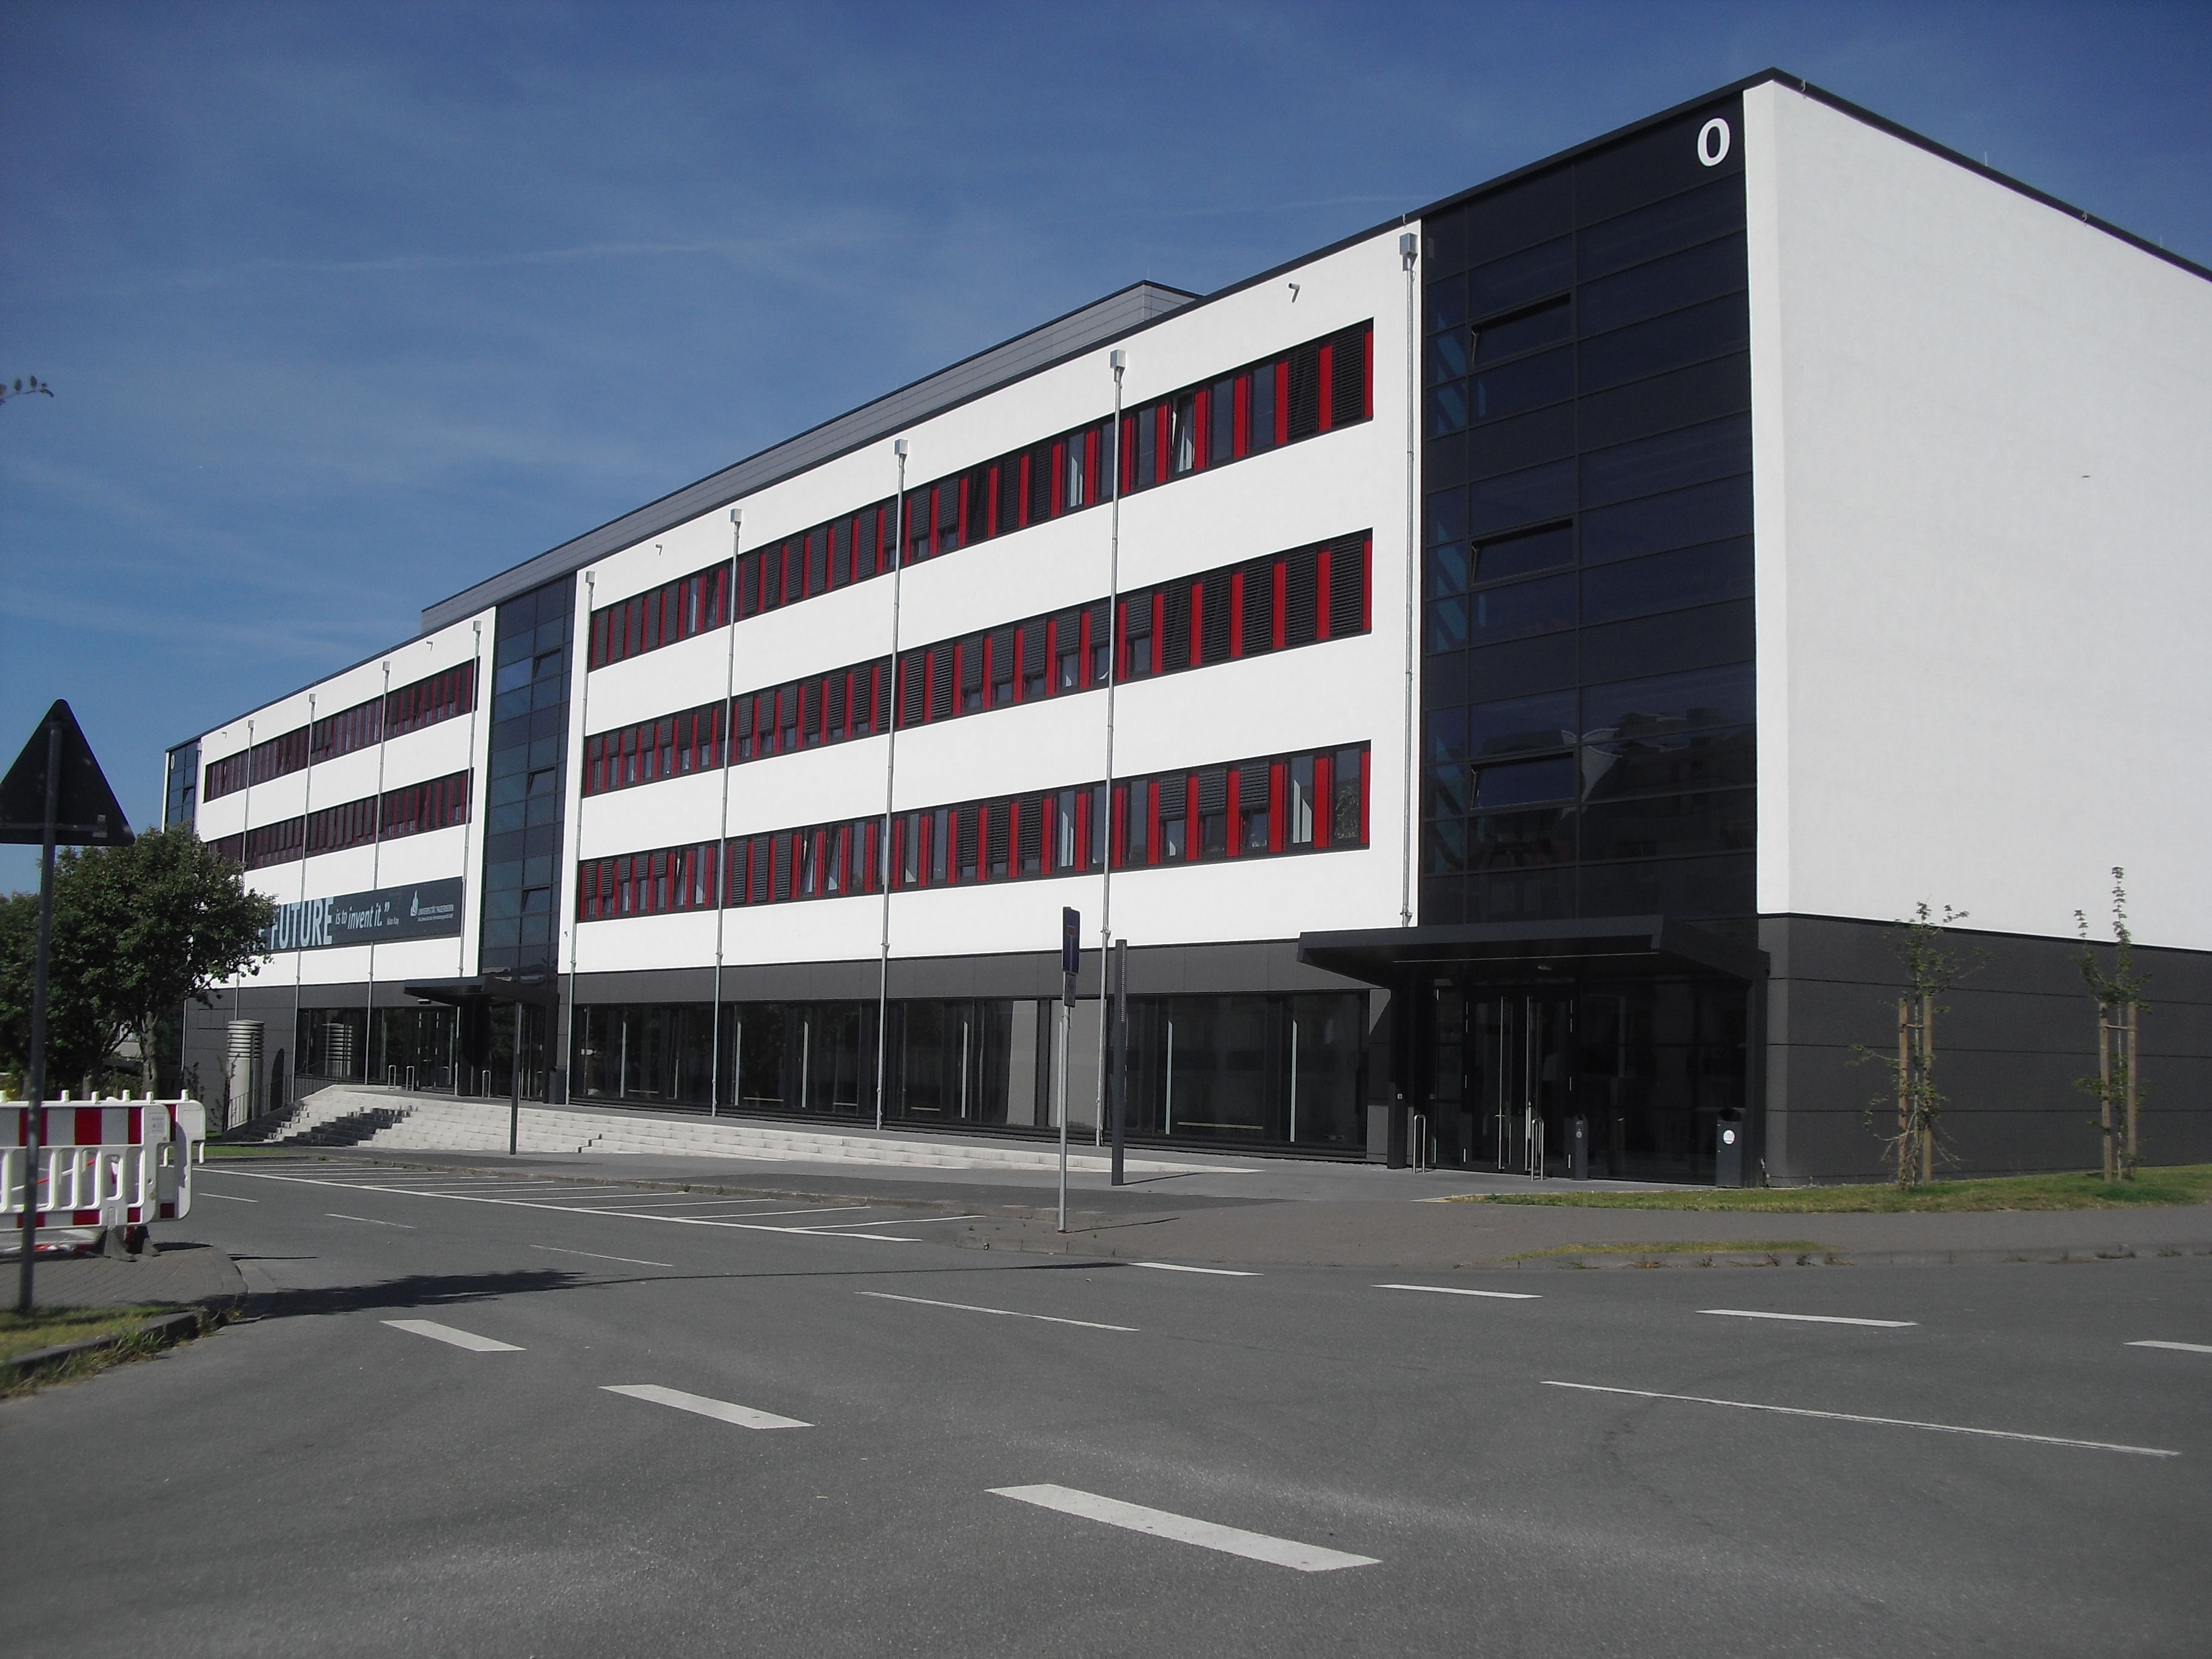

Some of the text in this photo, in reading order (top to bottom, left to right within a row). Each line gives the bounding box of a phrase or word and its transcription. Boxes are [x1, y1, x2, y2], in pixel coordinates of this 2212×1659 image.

[270, 897, 333, 950] FUTURE
[335, 909, 341, 925] is
[341, 910, 347, 925] to
[347, 906, 374, 930] invent
